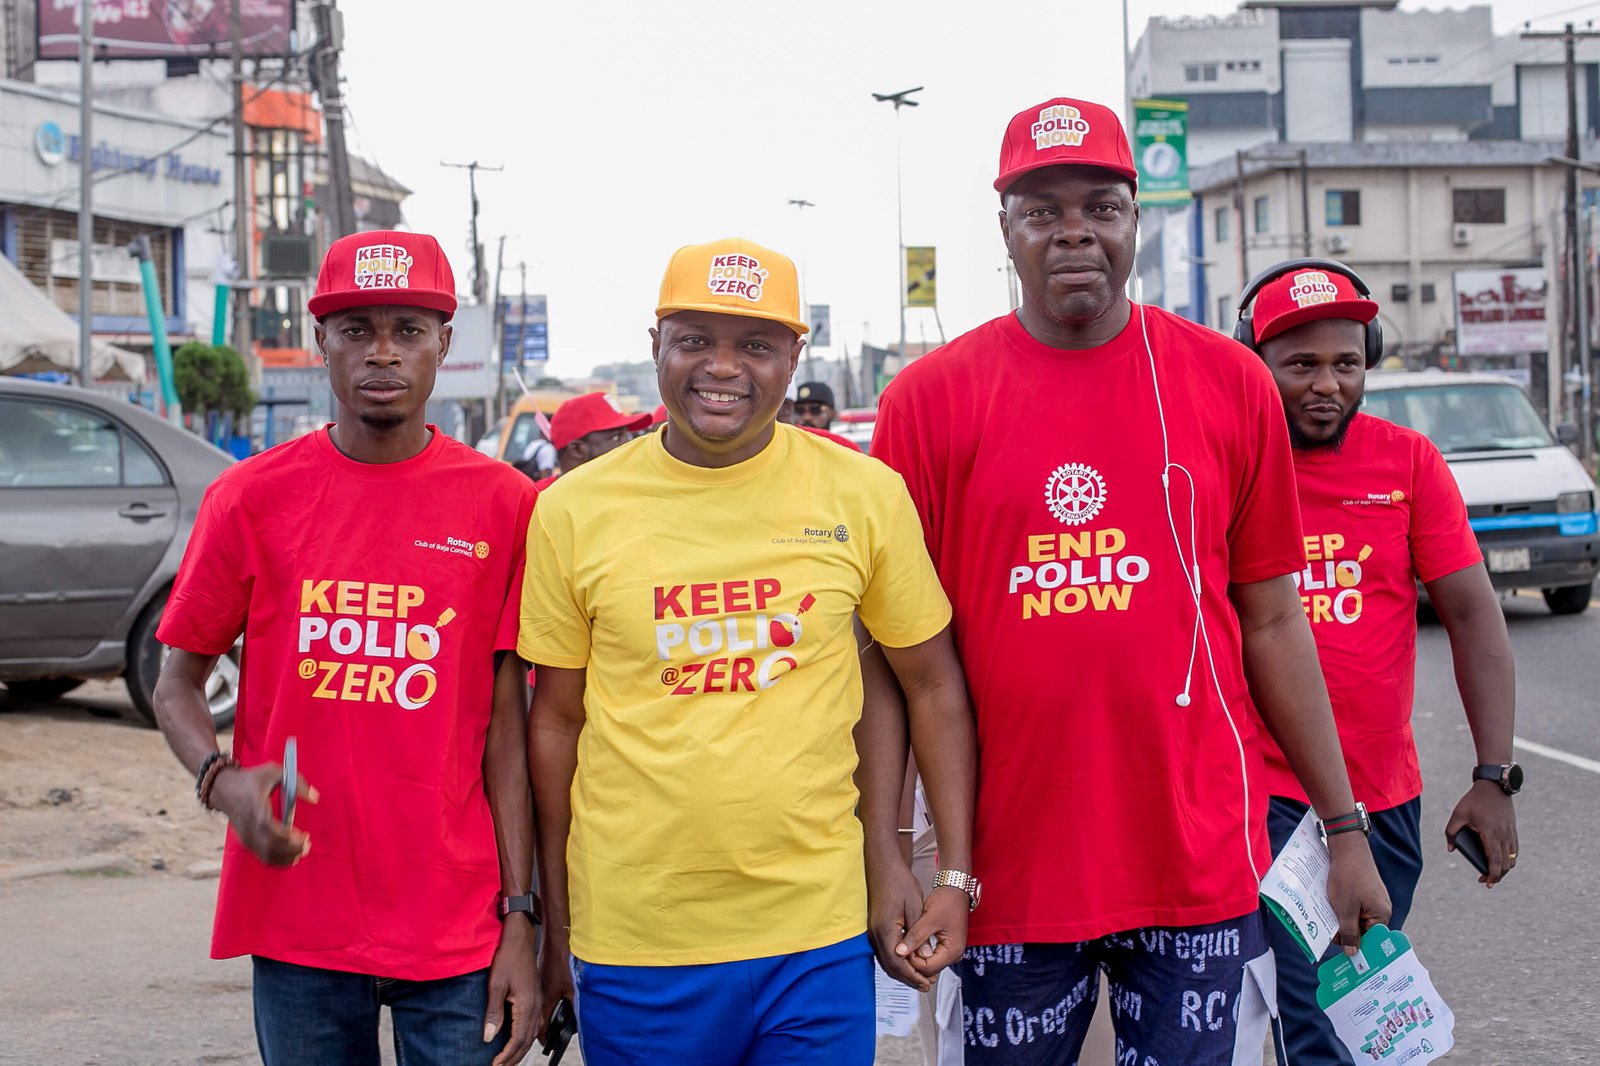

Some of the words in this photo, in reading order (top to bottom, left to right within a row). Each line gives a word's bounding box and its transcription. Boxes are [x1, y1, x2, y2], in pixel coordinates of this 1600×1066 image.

[1041, 106, 1078, 121] END
[1033, 118, 1087, 137] POLIO
[1038, 131, 1081, 147] NOW
[358, 247, 405, 261] KEEP
[713, 255, 758, 270] KEEP
[357, 258, 408, 276] POLIO
[711, 267, 762, 286] POLIO
[1295, 273, 1327, 286] END
[710, 280, 761, 300] @ZERO
[1292, 283, 1336, 298] POLIO
[1299, 293, 1334, 307] NOW
[1061, 469, 1089, 478] ROTARY
[1367, 493, 1391, 501] Rotary
[1054, 501, 1099, 520] INTERNATIONAL
[771, 537, 786, 545] Club
[808, 537, 832, 545] Connect
[804, 528, 833, 539] Rotary
[414, 540, 429, 548] Club
[435, 543, 450, 553] Ikeja
[449, 546, 473, 558] Connect
[447, 536, 475, 551] Rotary
[1027, 528, 1127, 563] END
[1008, 555, 1150, 594] POLIO
[299, 579, 425, 618] KEEP
[654, 578, 782, 620] KEEP
[1022, 584, 1134, 620] NOW
[298, 616, 441, 661] POLIO
[655, 613, 803, 661] POLIO
[660, 650, 798, 696] @ZERO
[298, 658, 438, 710] @ZERO
[1180, 989, 1227, 1032] RC
